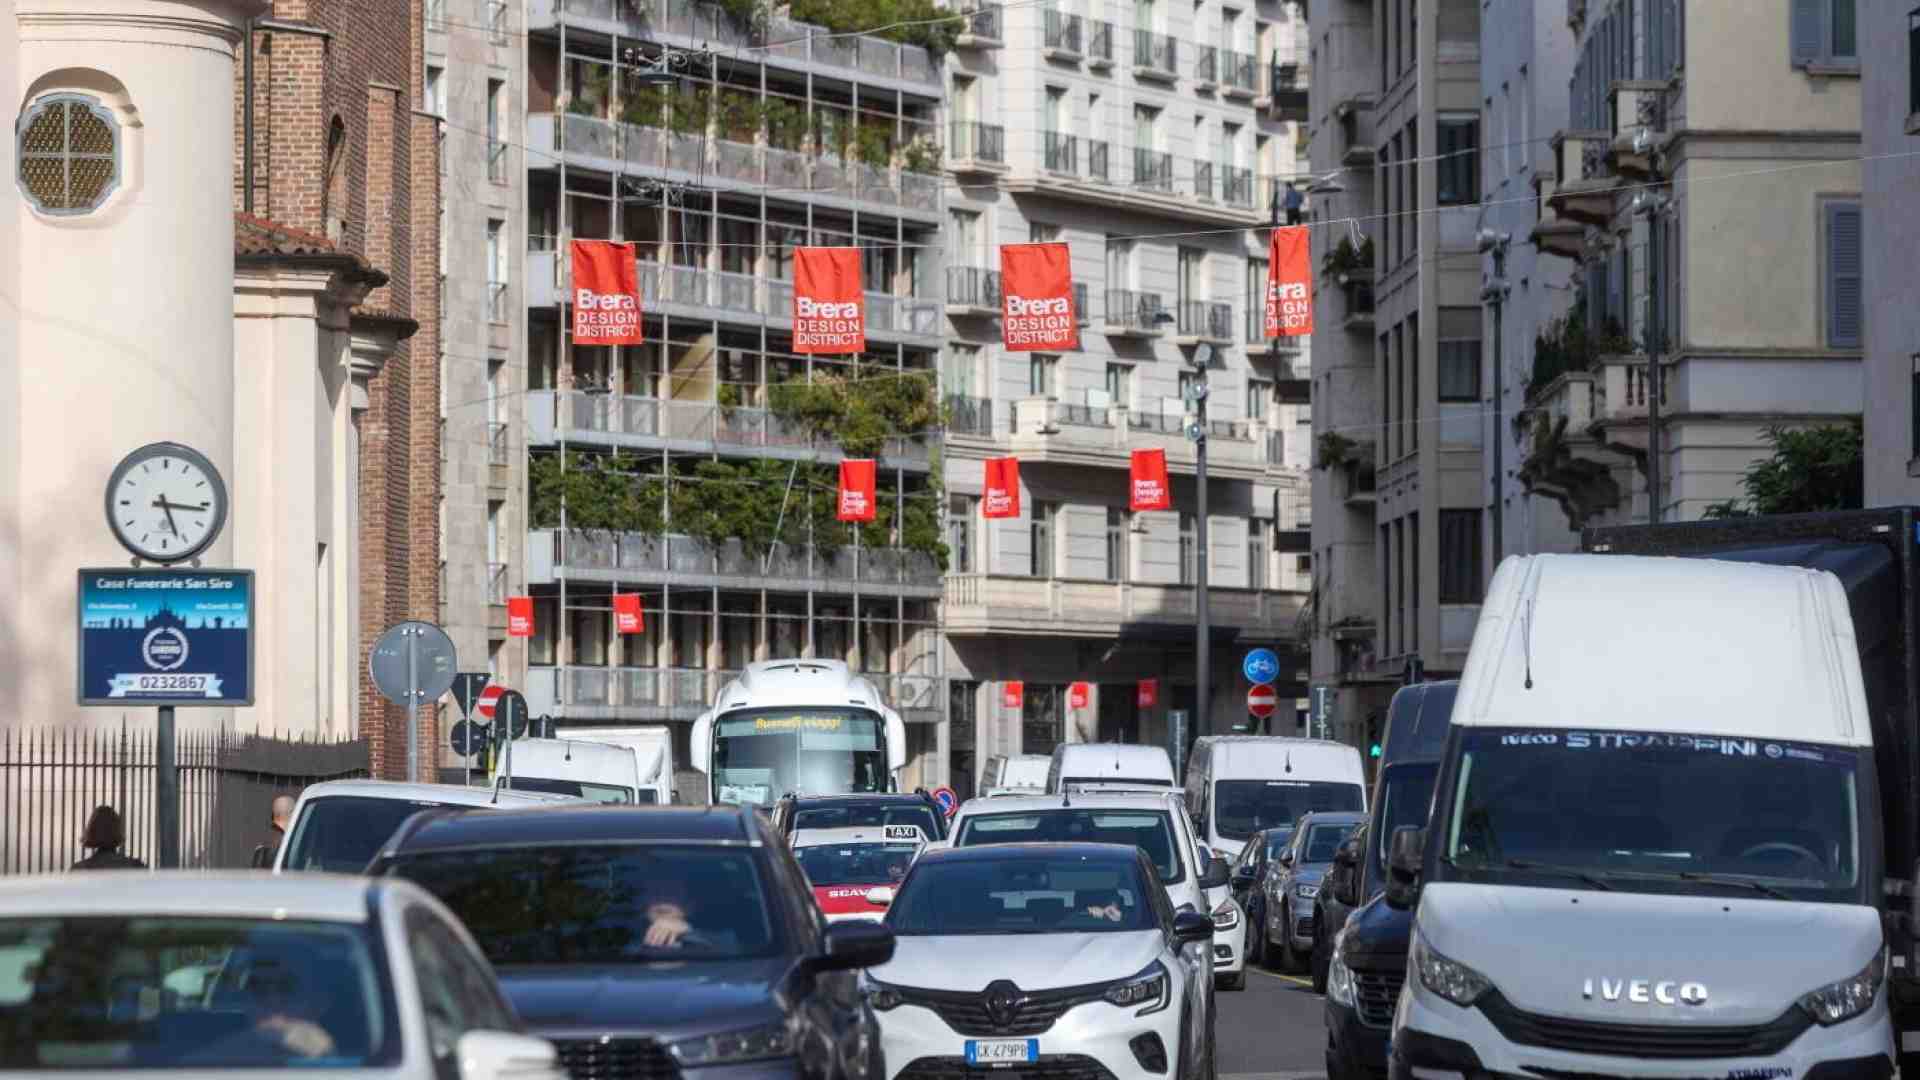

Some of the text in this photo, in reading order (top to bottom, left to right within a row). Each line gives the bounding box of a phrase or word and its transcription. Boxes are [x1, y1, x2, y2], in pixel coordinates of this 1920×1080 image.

[577, 288, 634, 310] Brera
[797, 297, 858, 318] Brera
[1007, 296, 1068, 316] Brera
[576, 311, 637, 324] DESIGN
[1007, 315, 1069, 330] DESIGN
[576, 324, 636, 337] DISTRICT
[797, 320, 859, 332] DESIGN
[797, 333, 859, 345] DISTRICT
[1007, 329, 1070, 344] DISTRICT
[96, 576, 233, 589] Case Funerarie San Siro
[140, 676, 208, 689] 0232867
[1501, 734, 1557, 745] IVECO
[890, 826, 915, 837] TAXI
[1582, 978, 1708, 1005] IVECO
